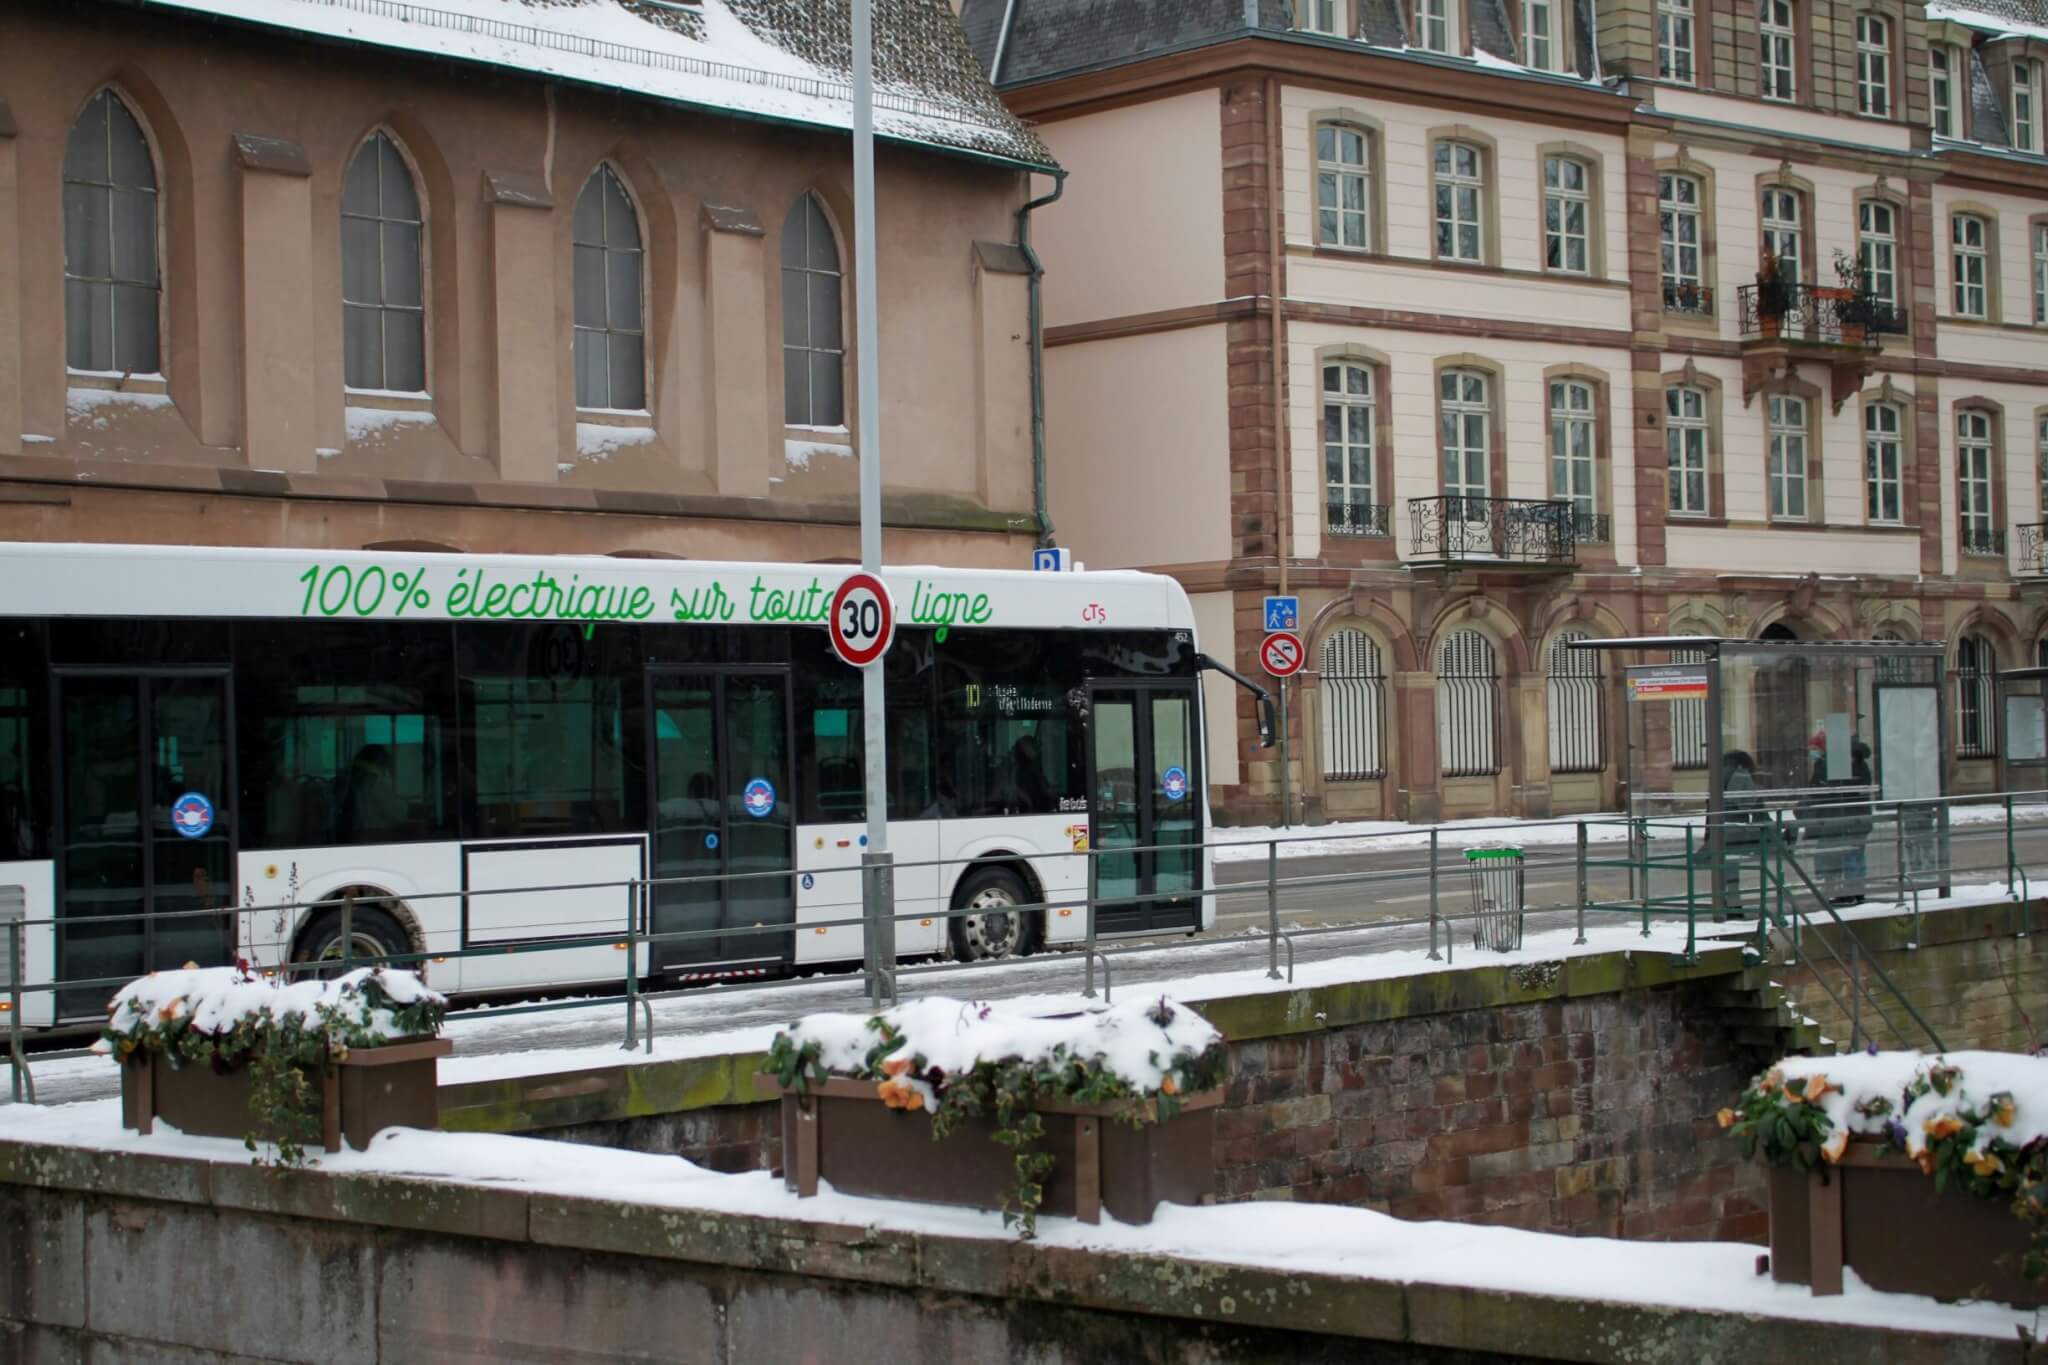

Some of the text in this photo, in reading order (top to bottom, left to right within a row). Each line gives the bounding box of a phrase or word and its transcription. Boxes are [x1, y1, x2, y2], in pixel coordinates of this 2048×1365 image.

[1039, 553, 1056, 571] P
[299, 564, 431, 617] 100%
[446, 567, 655, 640] électrique
[670, 581, 735, 622] sur
[911, 579, 993, 643] ligne
[842, 599, 880, 640] 30
